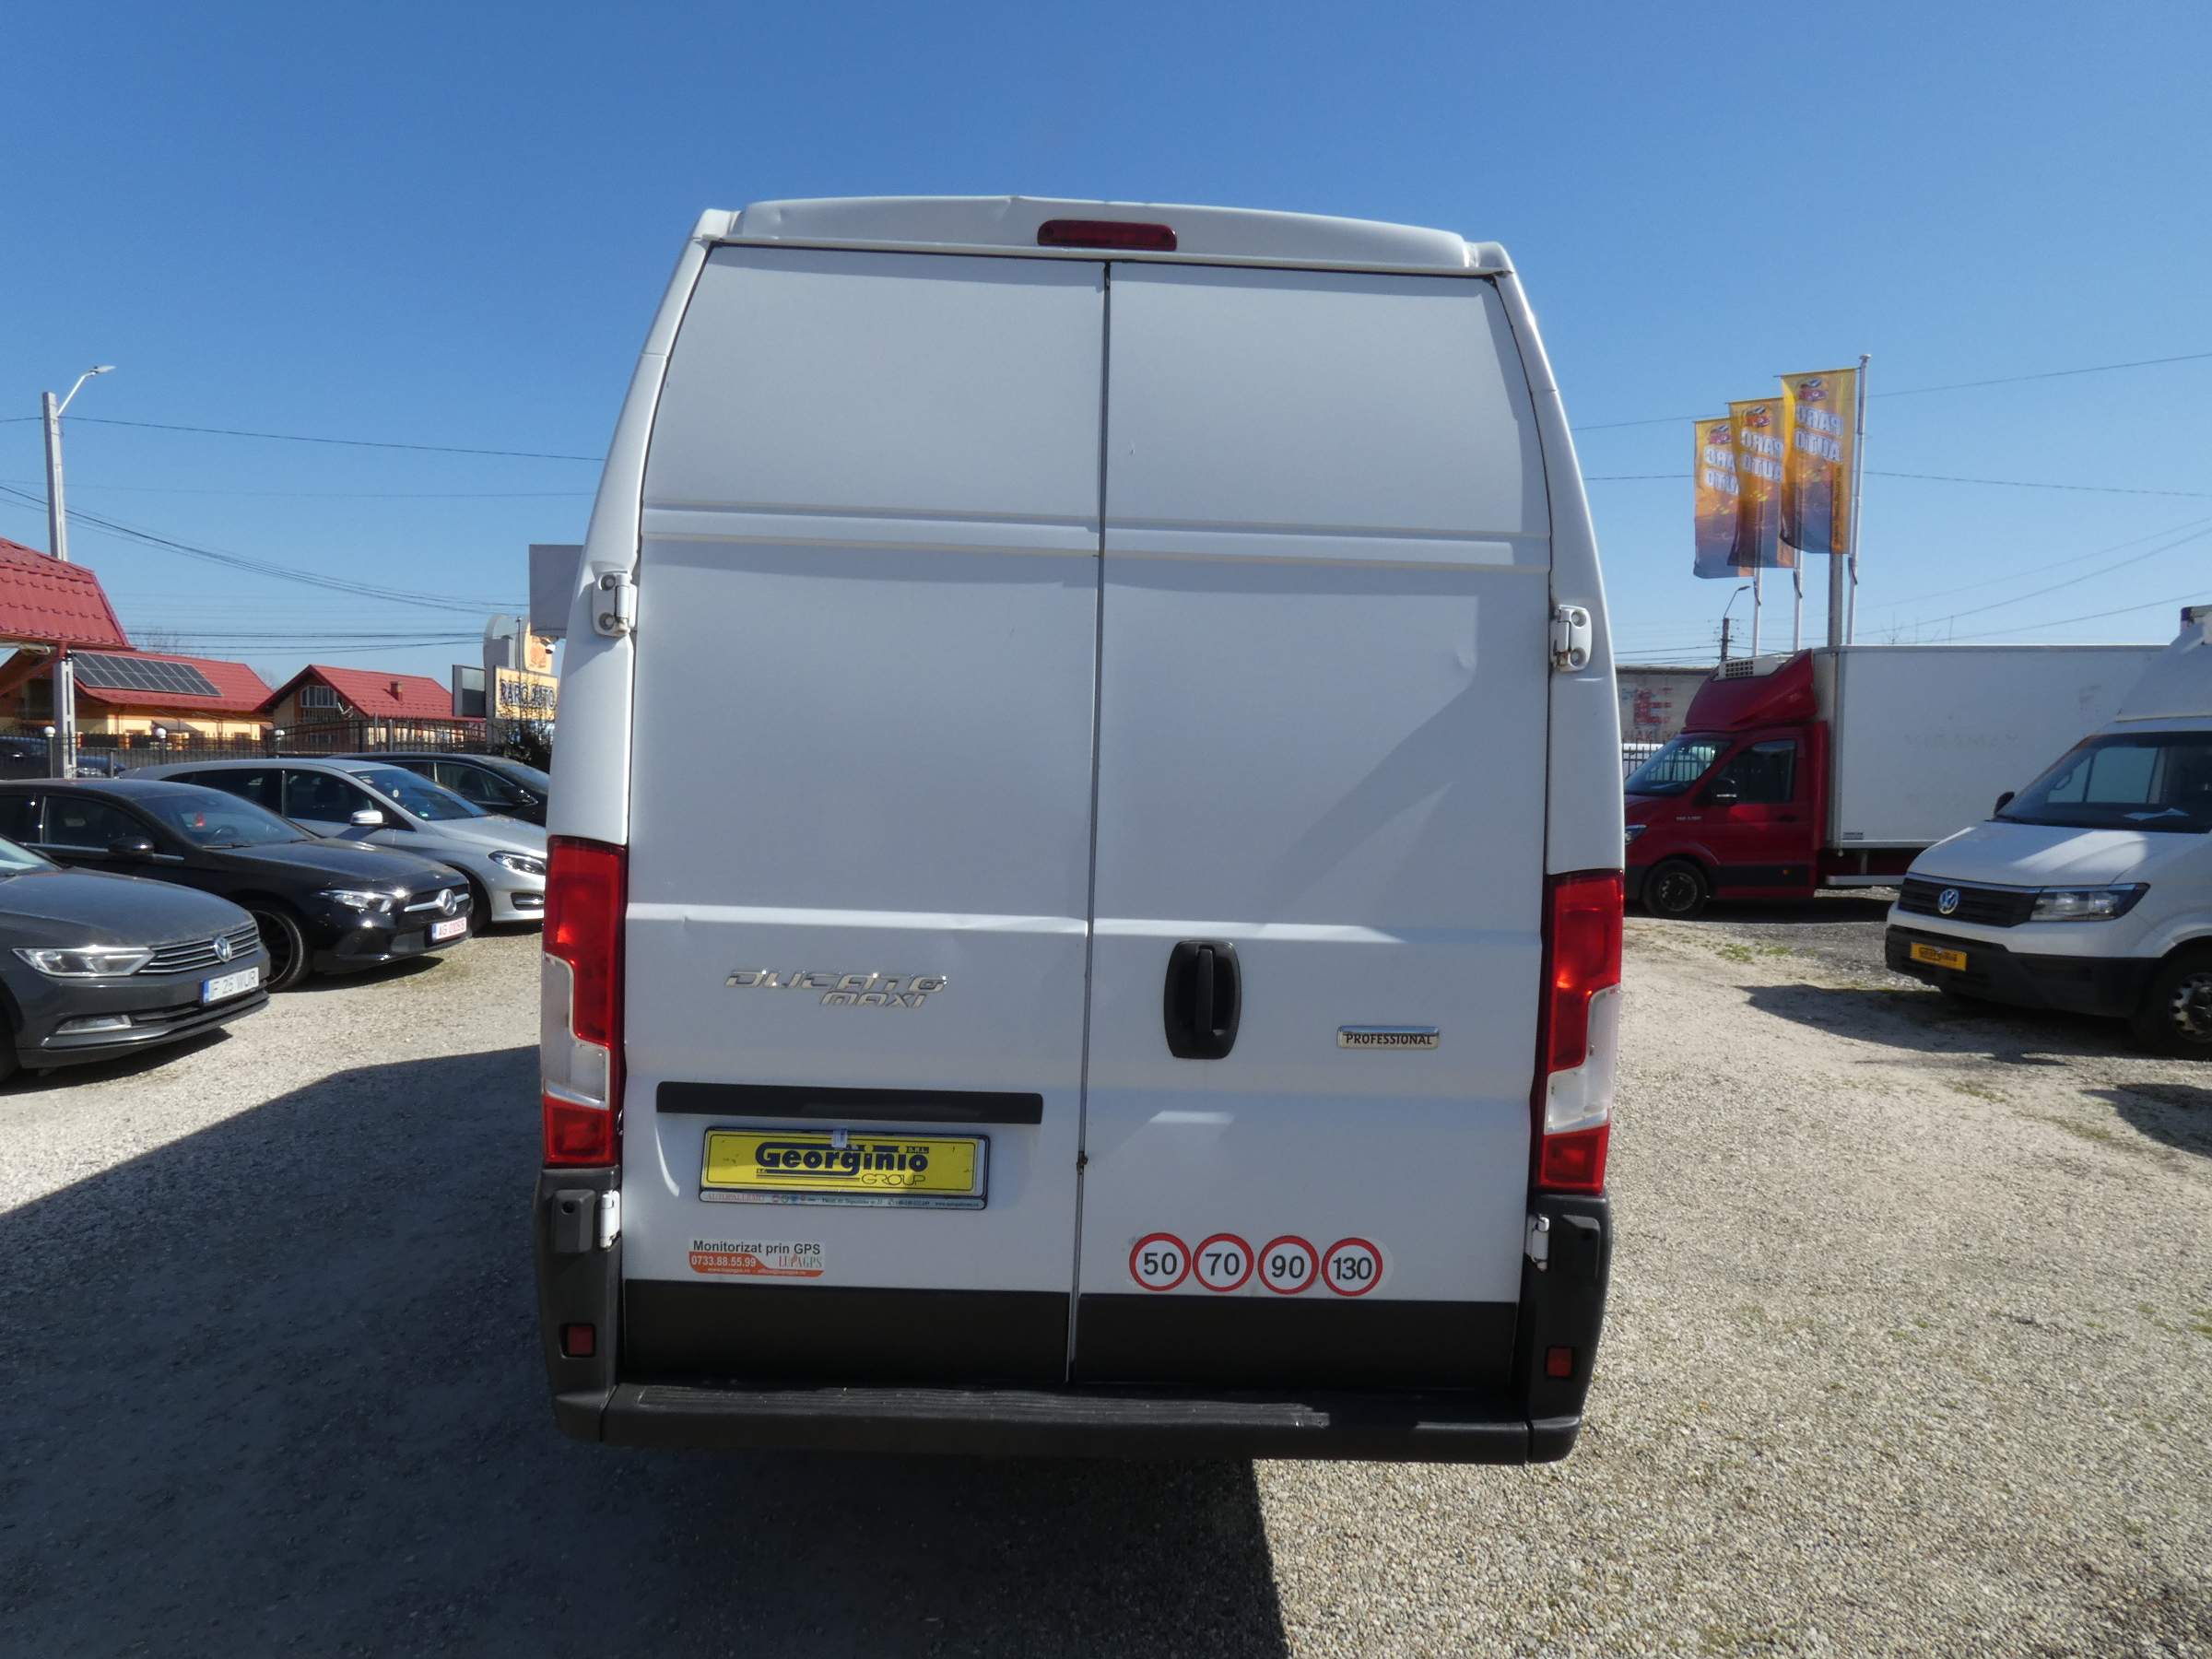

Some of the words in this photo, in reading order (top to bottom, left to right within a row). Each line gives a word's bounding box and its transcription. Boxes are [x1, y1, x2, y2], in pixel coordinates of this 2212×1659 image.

[725, 970, 947, 993] DUCATO
[819, 992, 928, 1008] MAXI
[1346, 1033, 1432, 1045] PROFESSIONAL
[756, 1142, 928, 1176] Georginio
[861, 1173, 926, 1186] GROUP
[693, 1240, 762, 1253] Monitorizat
[766, 1242, 790, 1255] prin
[794, 1243, 820, 1254] GPS
[1143, 1252, 1178, 1277] 50
[1205, 1253, 1241, 1277] 70
[1271, 1254, 1305, 1279] 90
[1333, 1256, 1372, 1280] 130
